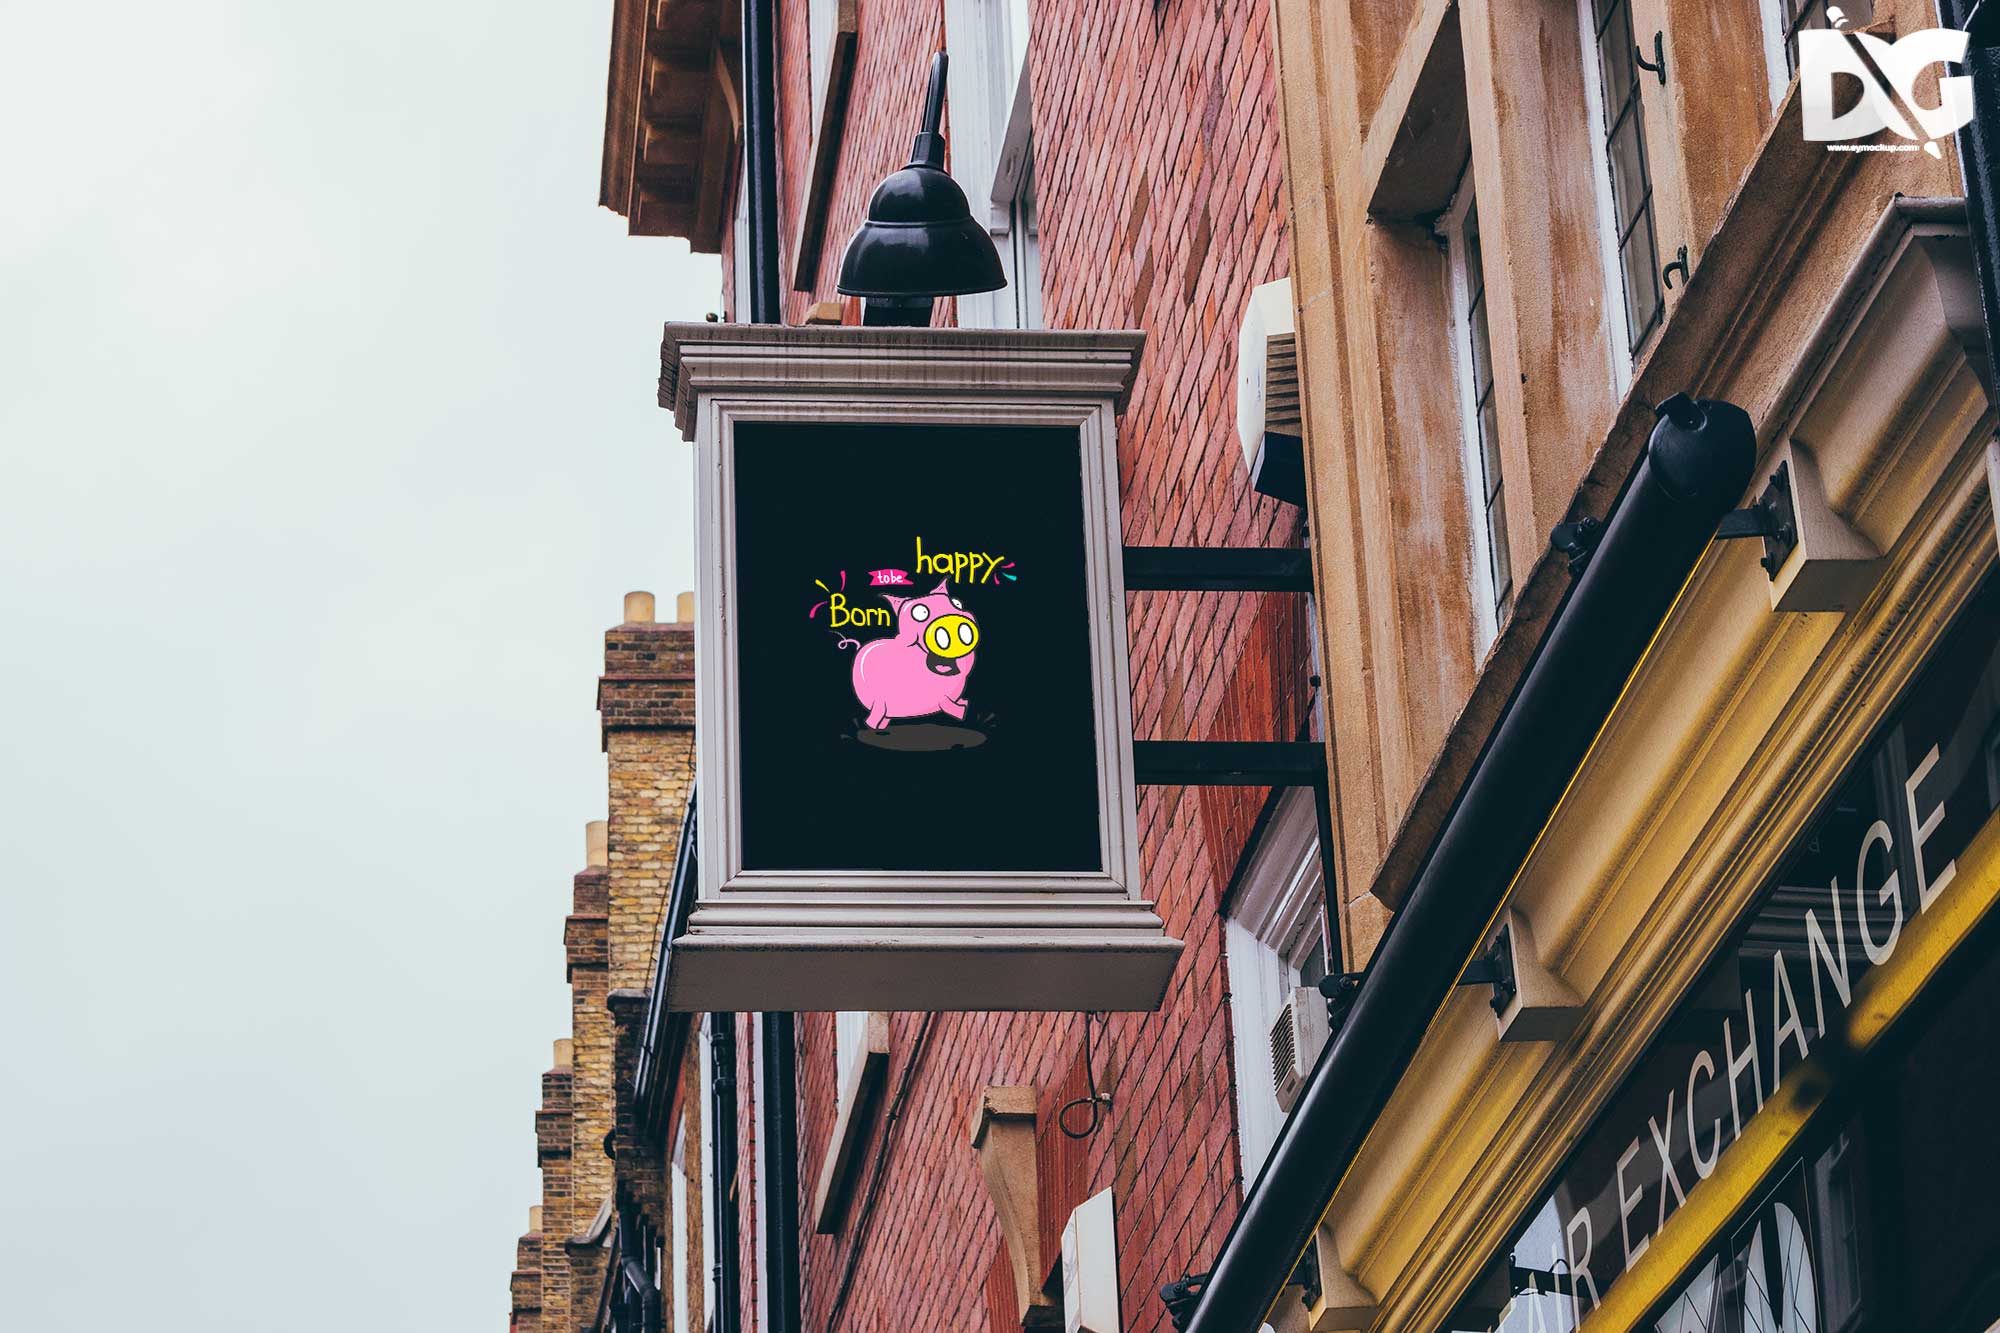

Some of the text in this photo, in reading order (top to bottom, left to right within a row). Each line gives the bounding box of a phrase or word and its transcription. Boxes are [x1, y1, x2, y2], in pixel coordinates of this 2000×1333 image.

[830, 592, 891, 627] Born
[916, 536, 1005, 584] happy
[1616, 743, 1957, 1274] EXCHANGE
